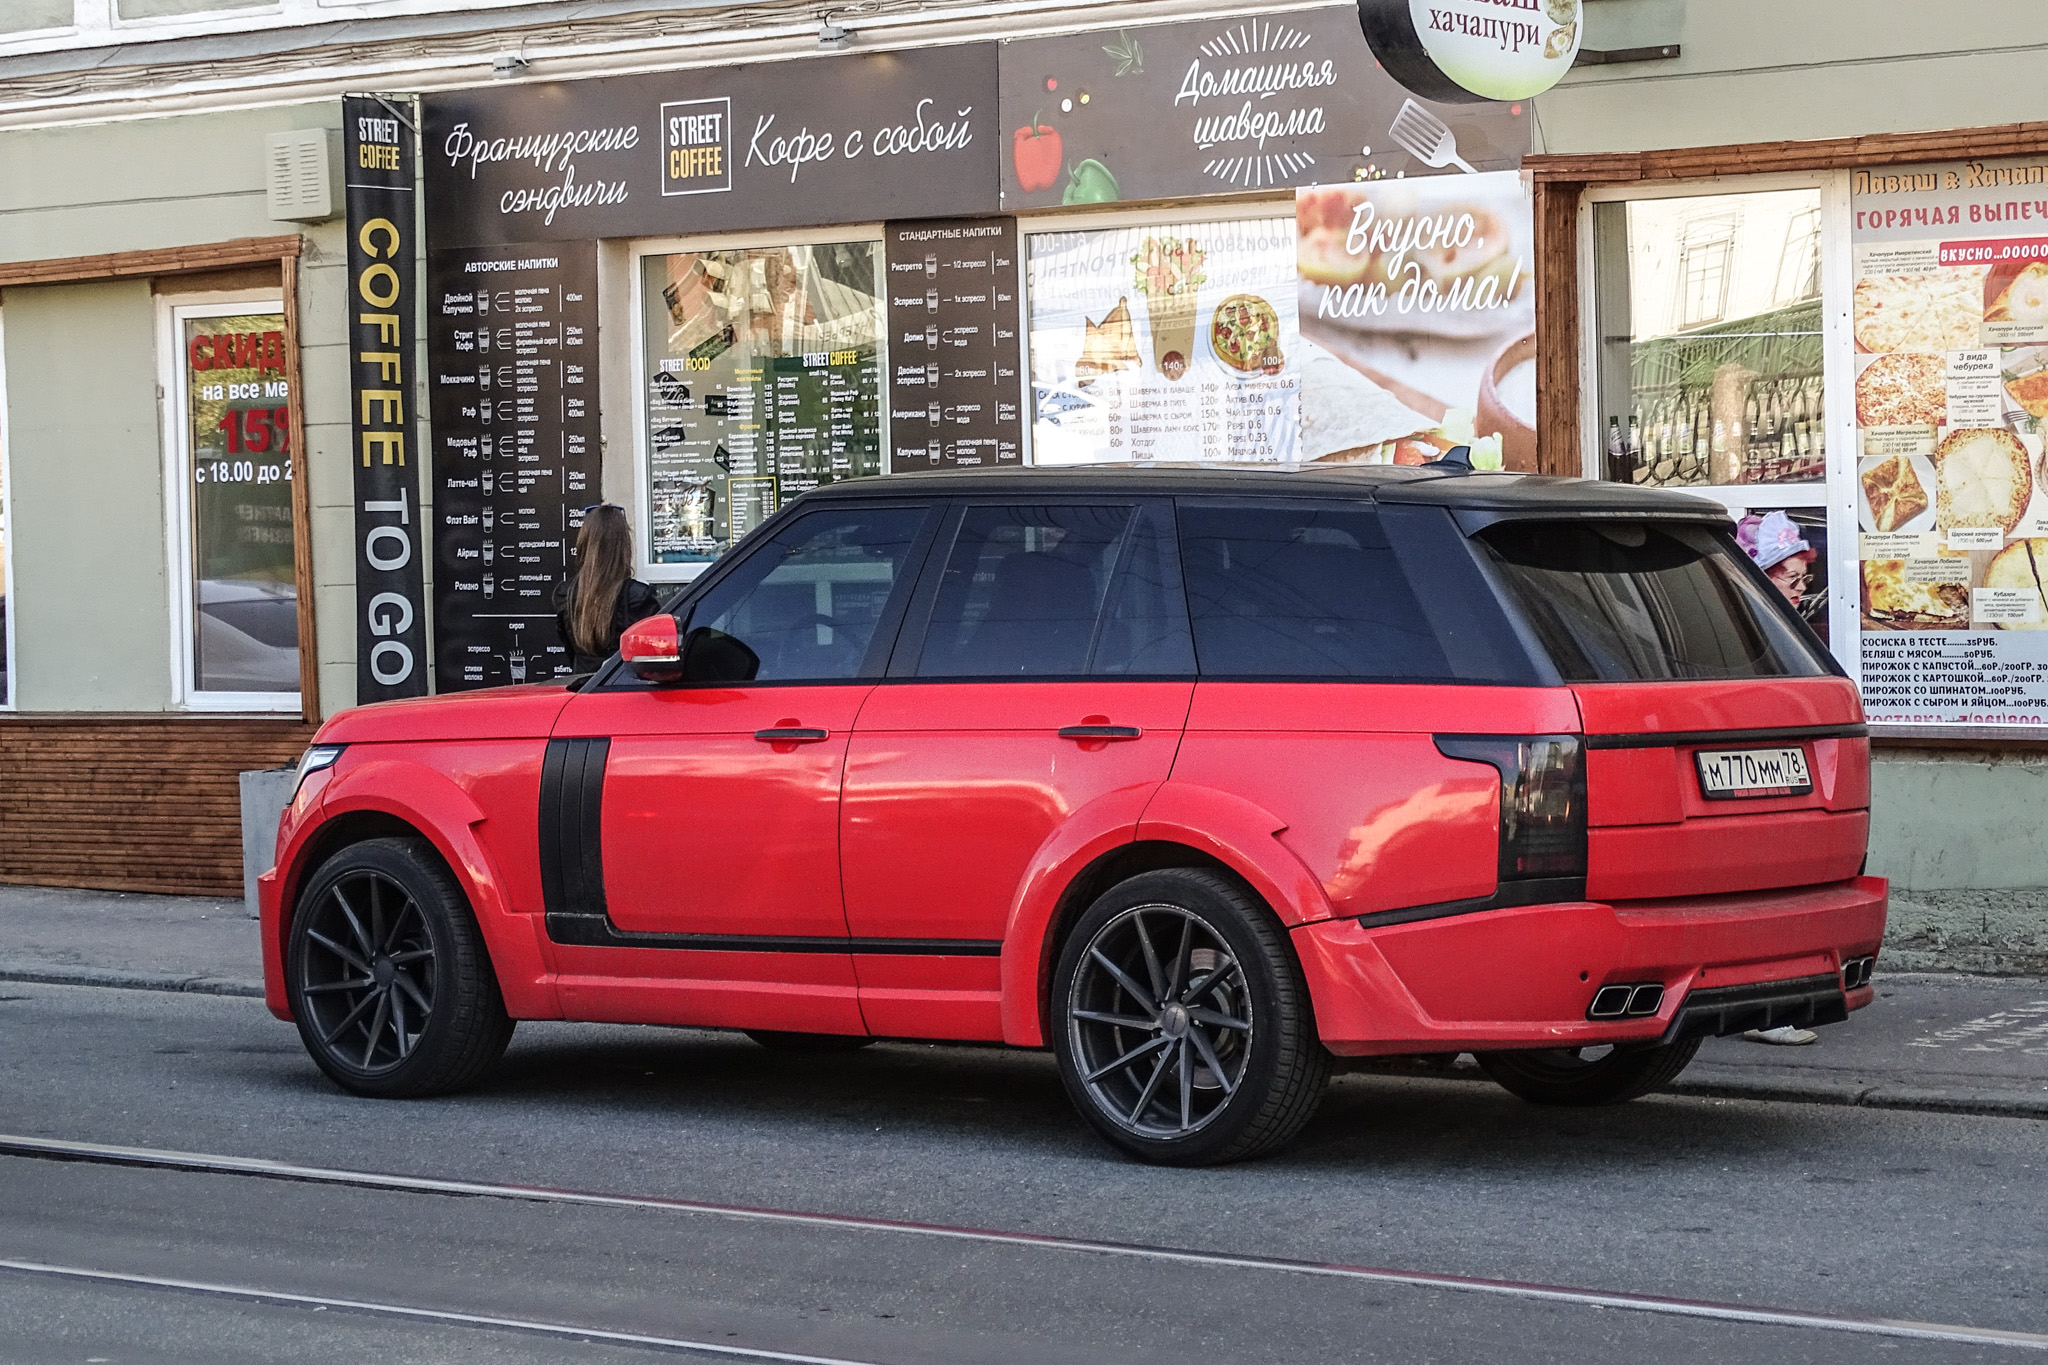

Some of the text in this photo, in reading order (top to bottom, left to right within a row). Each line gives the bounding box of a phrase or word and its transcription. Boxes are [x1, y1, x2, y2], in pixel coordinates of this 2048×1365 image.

[1429, 8, 1540, 53] хачапури
[1174, 58, 1337, 107] Домашняя
[358, 117, 399, 144] STREET
[669, 112, 723, 148] STREET
[1193, 105, 1327, 152] шаверма
[744, 98, 974, 182] Кофе с собой
[445, 121, 639, 179] Французские
[359, 144, 400, 170] COFFEE
[669, 146, 723, 179] COFFEE
[1855, 160, 2048, 195] Лаваш & Хачап
[500, 164, 629, 225] сэндвичи
[1856, 205, 1960, 230] ГОРЯЧАЯ
[900, 227, 1002, 241] СТАНДАРТНЫЕ НАПИТКИ
[1343, 200, 1485, 282] Вкусно,
[465, 258, 558, 273] АВТОРСКИЕ НАПИТКИ
[892, 262, 922, 272] Ристретто
[1318, 275, 1388, 320] как
[1394, 256, 1524, 317] дома!
[445, 294, 473, 304] Двойной
[894, 297, 923, 306] Эспрессо
[443, 305, 473, 314] Капучино
[454, 330, 473, 339] Стрит
[904, 334, 924, 343] Допио
[456, 342, 474, 351] Кофе
[803, 350, 857, 367] STREET COFFEE
[1959, 353, 1964, 361] 3
[660, 357, 710, 371] STREET FOOD
[1954, 362, 1994, 371] чебурека
[898, 366, 924, 376] Двойной
[441, 375, 475, 384] Моккачино
[1280, 379, 1294, 388] 0.6
[203, 385, 223, 400] на
[229, 383, 259, 399] все
[1250, 394, 1263, 402] 0.6
[462, 407, 476, 418] Раф
[892, 410, 926, 419] Американо
[1268, 406, 1281, 415] 0.6
[1248, 420, 1262, 429] 0.6
[447, 437, 477, 447] Медовый
[1249, 433, 1267, 442] 0.33
[359, 218, 414, 686] COFFEE TO GO
[463, 449, 478, 458] Раф
[897, 448, 926, 457] Капучино
[1260, 446, 1273, 454] 0.6
[196, 467, 205, 483] с
[210, 461, 253, 482] 18.00
[257, 465, 279, 484] до
[446, 515, 479, 526] Флэт Вайт
[457, 548, 479, 558] Айриш
[455, 581, 479, 590] Романо
[1862, 638, 1906, 646] СОСИСКА
[1909, 638, 1915, 646] В
[1898, 650, 1904, 658] С
[1862, 662, 1910, 670] ПИРОЖОК
[1914, 662, 1919, 670] С
[1862, 674, 1910, 682] ПИРОЖОК
[1914, 674, 1920, 682] С
[1862, 686, 1910, 695] ПИРОЖОК
[1914, 686, 1926, 694] СО
[1863, 698, 1911, 707] ПИРОЖОК
[1914, 698, 1920, 706] С
[1923, 698, 1958, 706] СЫРОМ
[1962, 698, 1968, 706] И
[1786, 776, 1798, 784] RUS
